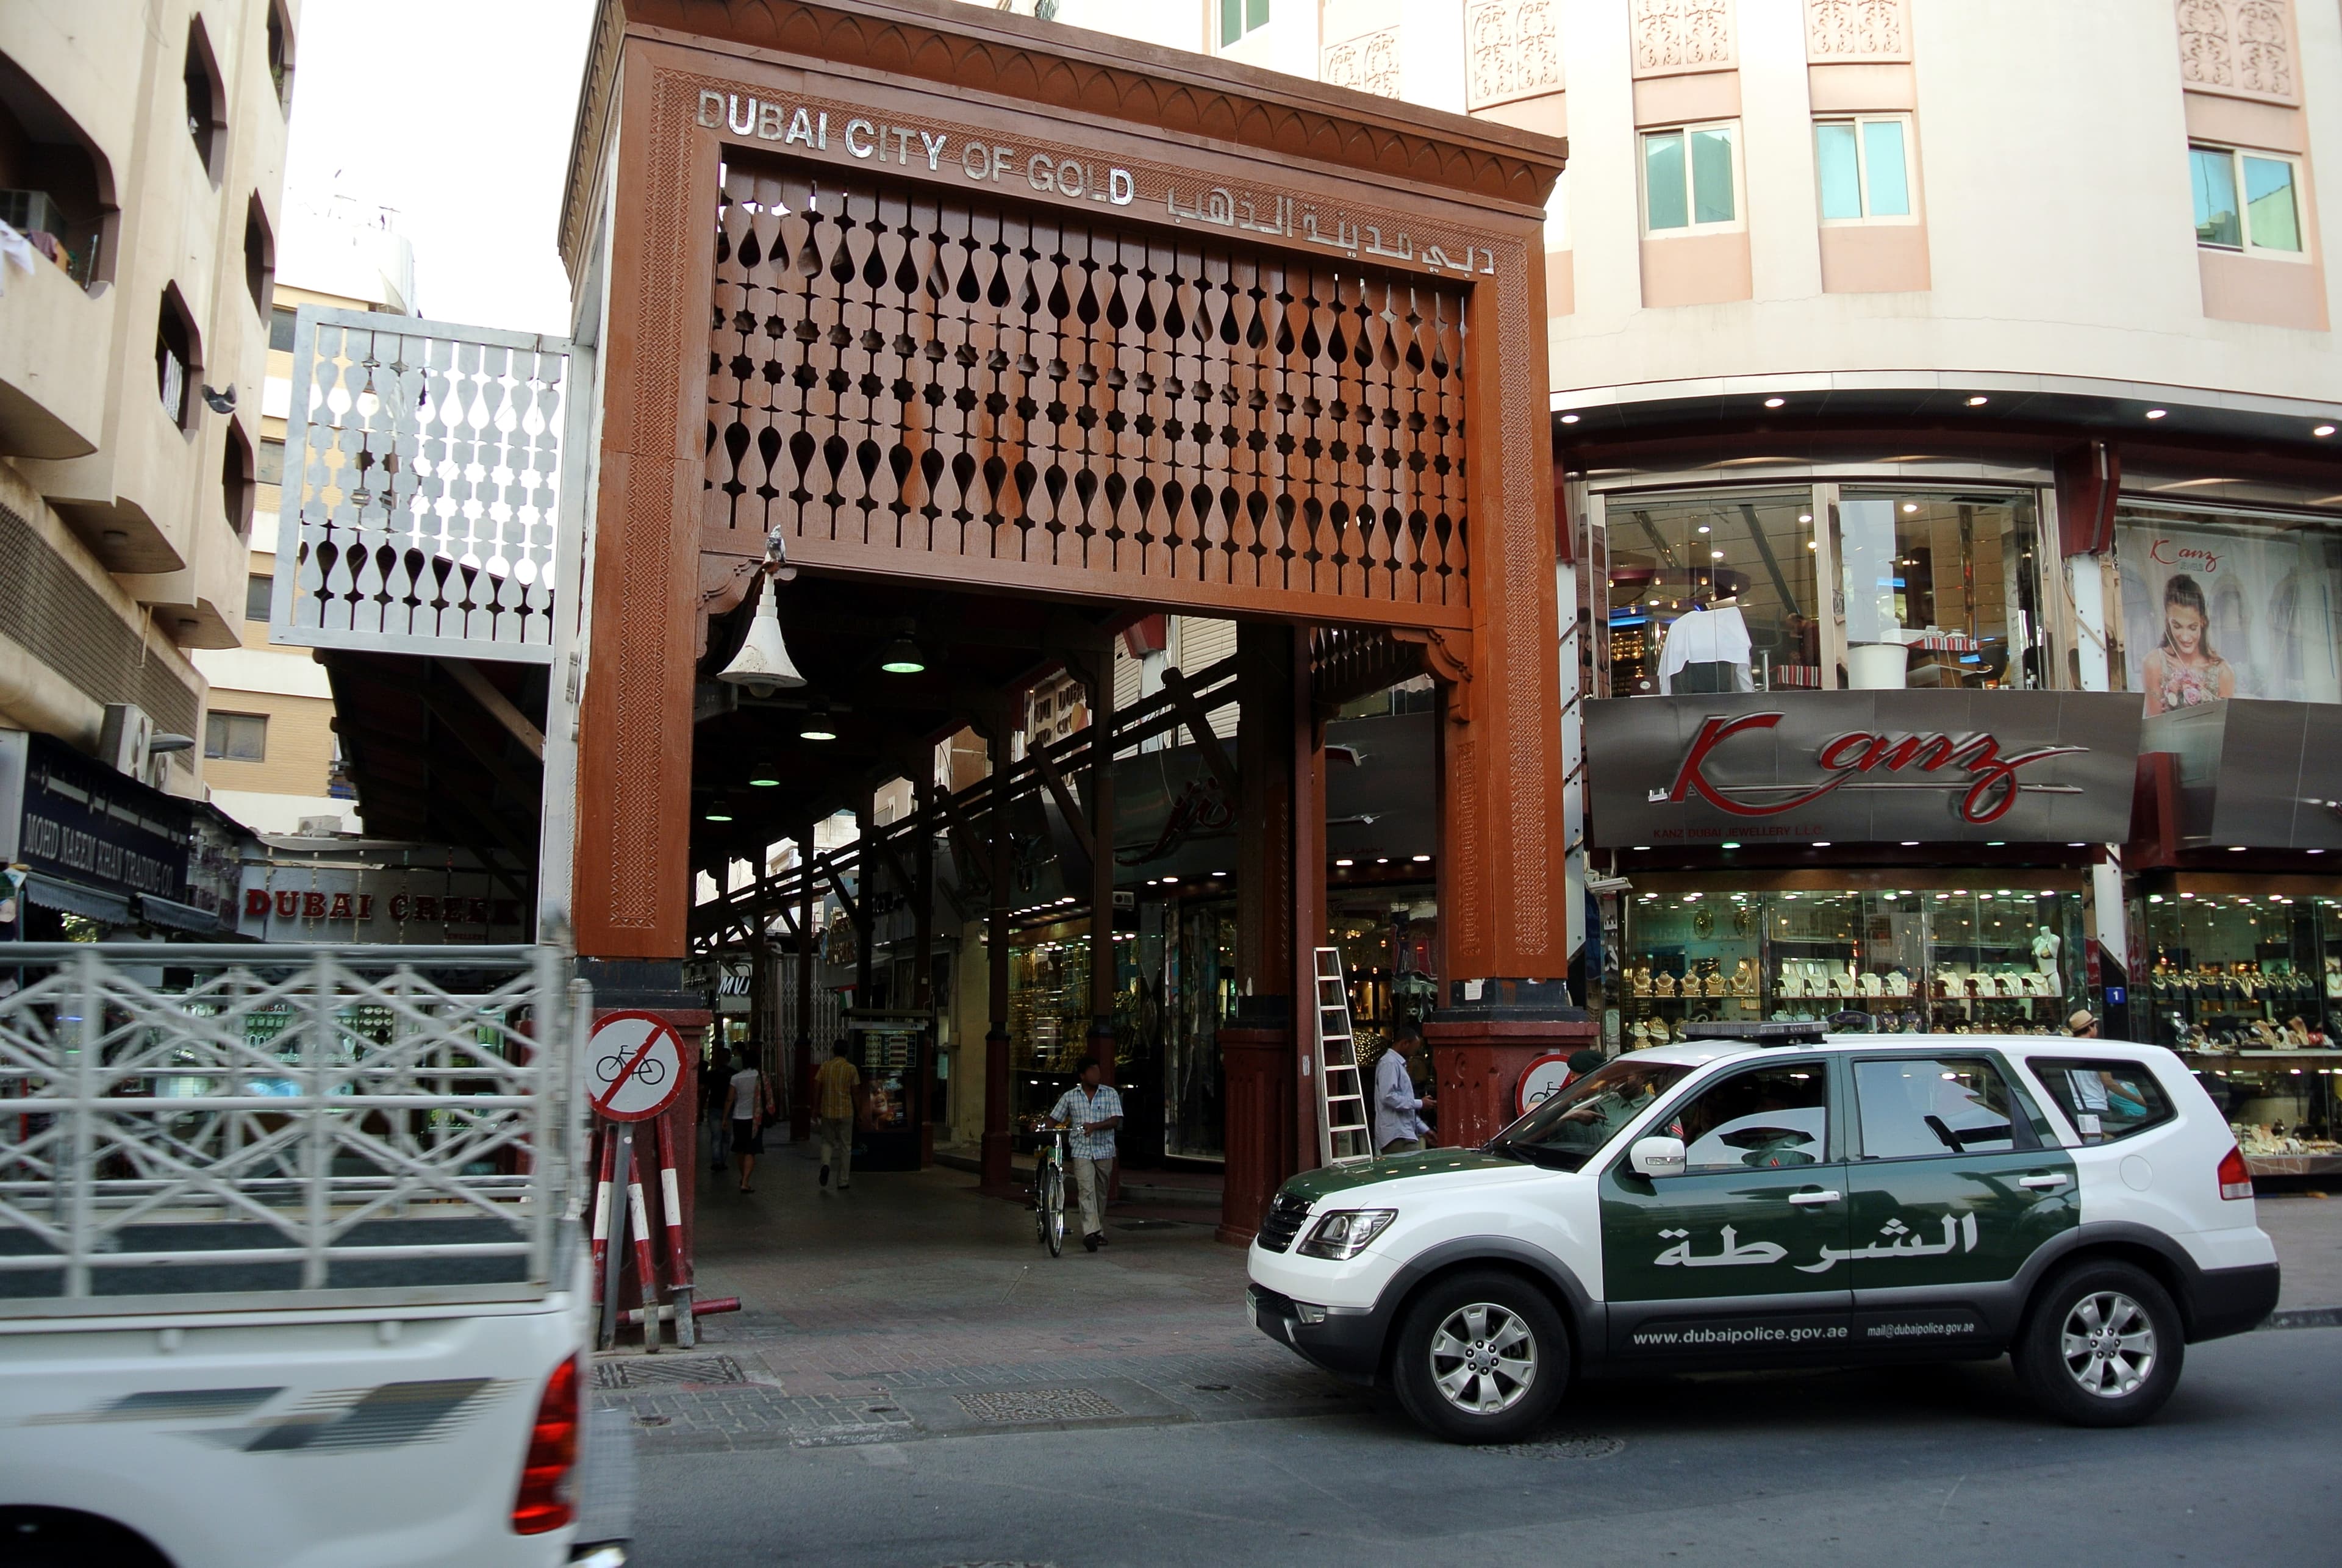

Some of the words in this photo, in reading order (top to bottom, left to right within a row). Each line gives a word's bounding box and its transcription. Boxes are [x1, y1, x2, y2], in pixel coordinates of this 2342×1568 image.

[698, 89, 828, 151] DUBAI
[845, 119, 947, 171] CITY
[962, 141, 1014, 182] OF
[1026, 154, 1134, 206] GOLD
[1167, 187, 1294, 238] الذهب
[1303, 203, 1413, 260] مدينة
[1422, 245, 1495, 279] دبي
[2150, 539, 2225, 572] Kanz
[1669, 711, 2090, 825] Kanz
[1653, 829, 1684, 839] KANZ
[1688, 828, 1721, 837] DUBAI
[1725, 826, 1791, 837] JEWELLERY
[24, 813, 60, 860] MOHD
[60, 826, 96, 872] NAEEM
[96, 840, 124, 881] KHAN
[124, 850, 161, 893] TRADING
[245, 889, 373, 921] DUBAI
[388, 895, 520, 925] CREEK
[2113, 990, 2119, 1001] 1
[1653, 1211, 1978, 1273] الشرطة
[1633, 1325, 1848, 1345] www.dubaipolice.gov.ae
[1867, 1321, 1975, 1337] mail@dubaipolice.gov.ae
